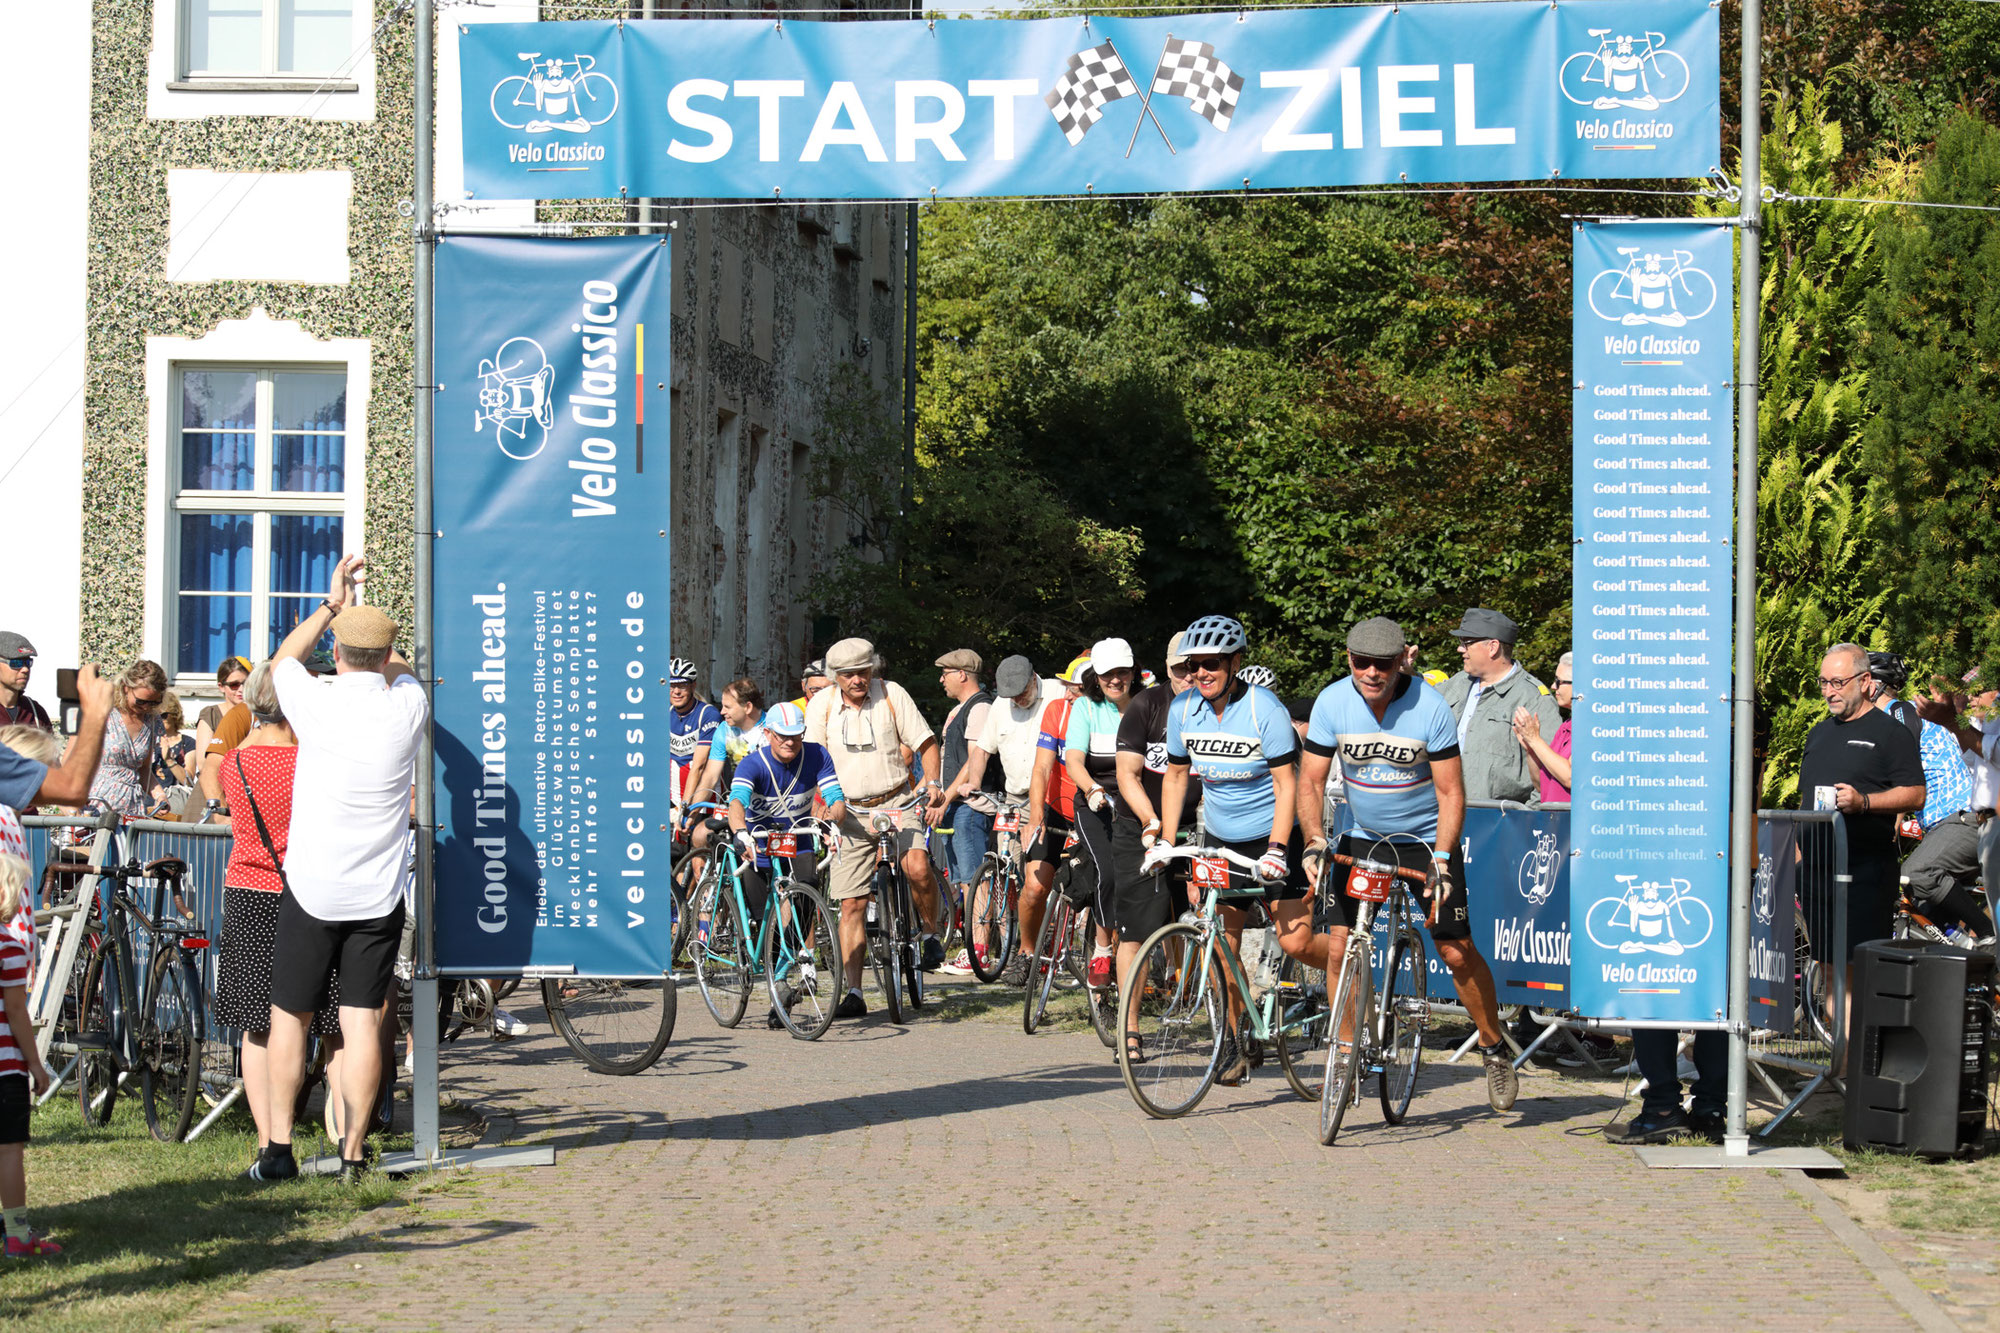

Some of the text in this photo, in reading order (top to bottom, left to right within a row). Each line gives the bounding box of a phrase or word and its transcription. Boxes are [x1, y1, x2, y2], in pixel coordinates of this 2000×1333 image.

[1260, 63, 1516, 152] ZIEL
[666, 78, 1039, 164] START
[1575, 117, 1673, 140] Velo Classico
[508, 141, 605, 164] Velo Classico
[1604, 335, 1700, 355] Velo Classico
[1594, 384, 1712, 397] Good Times ahead.
[568, 279, 618, 518] Velo Classico
[1593, 408, 1711, 421] Good Times ahead.
[1593, 433, 1711, 445] Good Times ahead.
[1593, 457, 1711, 470] Good Times ahead.
[1593, 482, 1711, 494] Good Times ahead.
[1593, 506, 1710, 519] Good Times ahead.
[1593, 531, 1710, 543] Good Times ahead.
[1593, 555, 1710, 568] Good Times ahead.
[1592, 579, 1710, 592] Good Times ahead.
[1592, 604, 1709, 616] Good Times ahead.
[1592, 628, 1709, 641] Good Times ahead.
[584, 591, 600, 737] Startplatz?
[1592, 653, 1709, 665] Good Times ahead.
[1592, 677, 1709, 690] Good Times ahead.
[1592, 701, 1708, 714] Good Times ahead.
[1592, 726, 1708, 738] Good Times ahead.
[1186, 739, 1260, 758] RITCHEY
[1343, 742, 1423, 764] RITCHEY
[472, 582, 508, 934] Good Times ahead.
[532, 590, 548, 927] Erlebe das ultimative Retro-Bike-Festival
[550, 590, 565, 927] im Glückswachstumsgebiet
[567, 590, 582, 927] Mecklenburgische Seenplatte
[619, 590, 645, 928] veloclassico.de
[1592, 750, 1708, 763] Good Times ahead.
[1197, 765, 1253, 779] L'Eroica
[1356, 766, 1418, 782] L'Eroica
[1591, 775, 1708, 787] Good Times ahead.
[1591, 799, 1707, 812] Good Times ahead.
[1591, 824, 1707, 836] Good Times ahead.
[584, 776, 598, 927] Mehr Infos?
[1591, 848, 1707, 861] Good Times ahead.
[1494, 917, 1520, 962] Velo
[1601, 962, 1697, 983] Velo Classico
